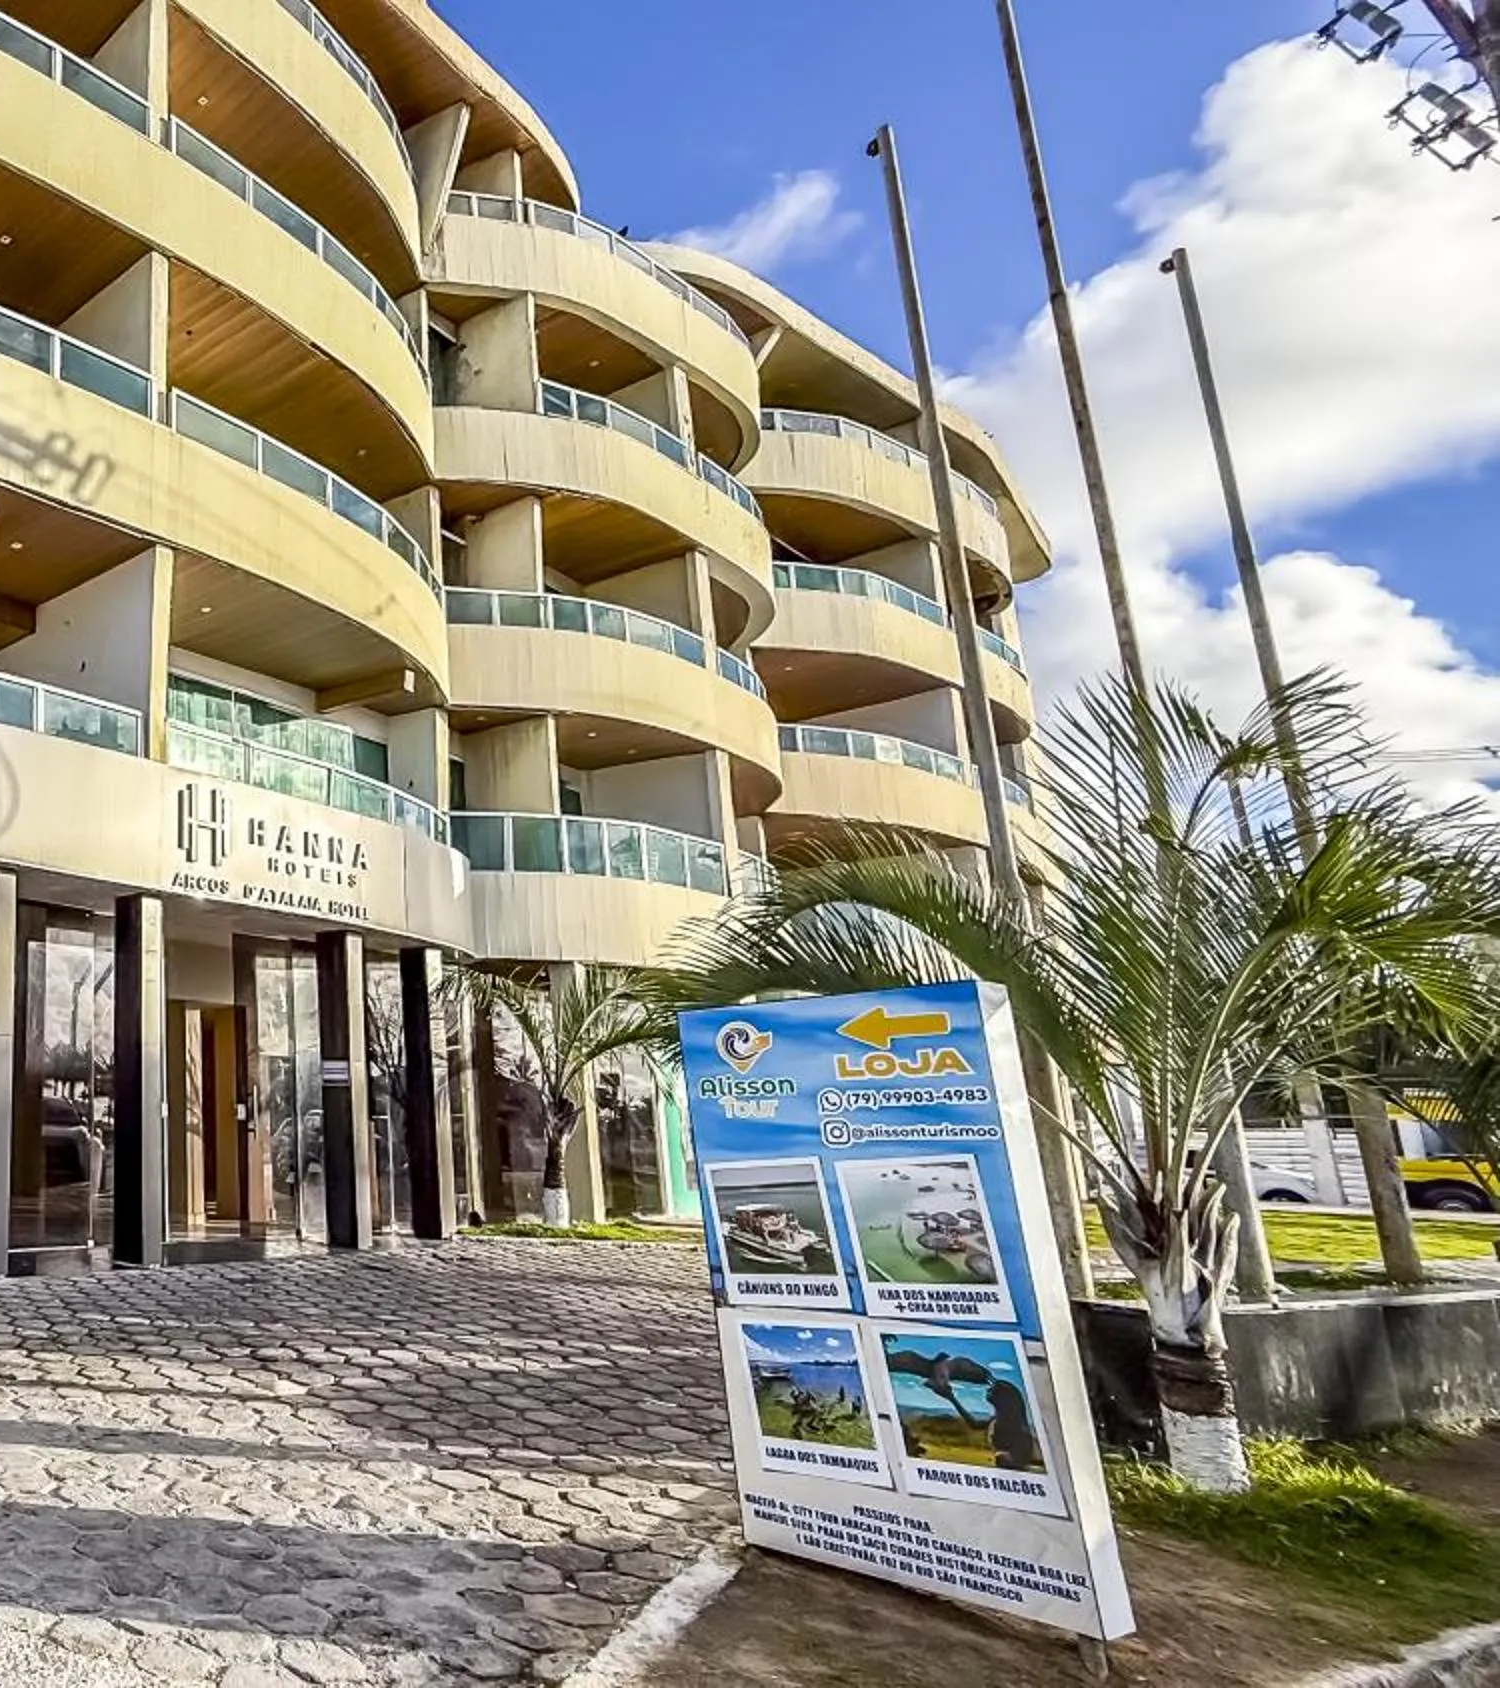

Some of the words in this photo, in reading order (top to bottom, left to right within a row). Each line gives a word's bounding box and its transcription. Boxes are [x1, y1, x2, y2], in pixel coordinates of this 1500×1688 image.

[248, 817, 369, 871] HANNA
[171, 872, 230, 895] ARCOS
[328, 901, 370, 921] HOTEL
[834, 1047, 975, 1080] LOJA
[700, 1074, 796, 1098] Alisson
[881, 1088, 988, 1104] 99903-4983
[851, 1125, 998, 1140] @alissonturismoo
[785, 1284, 800, 1295] DO
[903, 1290, 926, 1300] DOS
[927, 1290, 1000, 1303] NAMORADOS
[798, 1452, 818, 1464] DOS
[819, 1454, 879, 1473] TAMBAQUIS
[916, 1467, 963, 1485] PARQUE
[965, 1474, 990, 1489] DOS
[992, 1477, 1046, 1497] FALCÕES
[853, 1505, 901, 1526] PASSEIOS
[793, 1504, 813, 1519] CITY
[814, 1510, 839, 1524] TOUR
[988, 1552, 1036, 1574] FAZENDA
[889, 1542, 934, 1564] CIDADES
